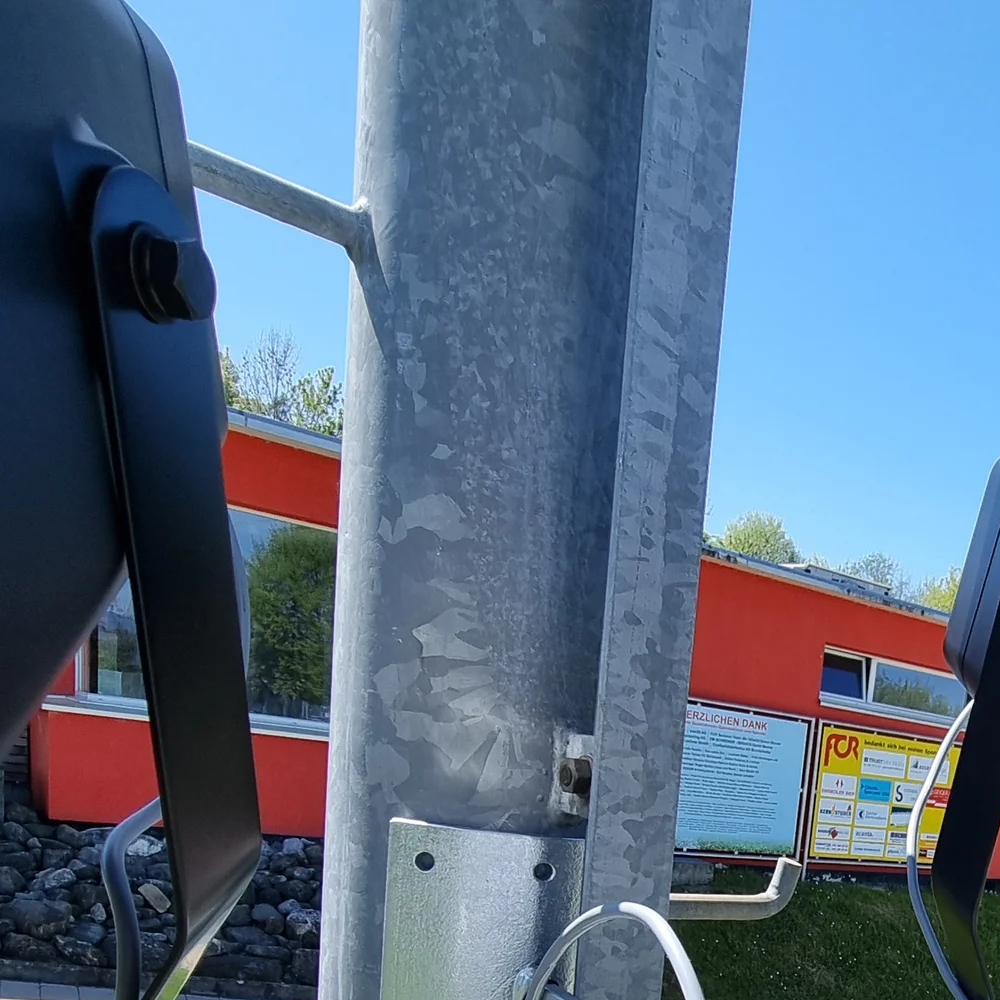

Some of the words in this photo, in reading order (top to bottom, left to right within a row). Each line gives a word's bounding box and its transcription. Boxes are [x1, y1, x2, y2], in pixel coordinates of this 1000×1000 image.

[686, 710, 740, 726] ERZLICHEN
[742, 719, 768, 731] DANK
[864, 739, 885, 747] bedankt
